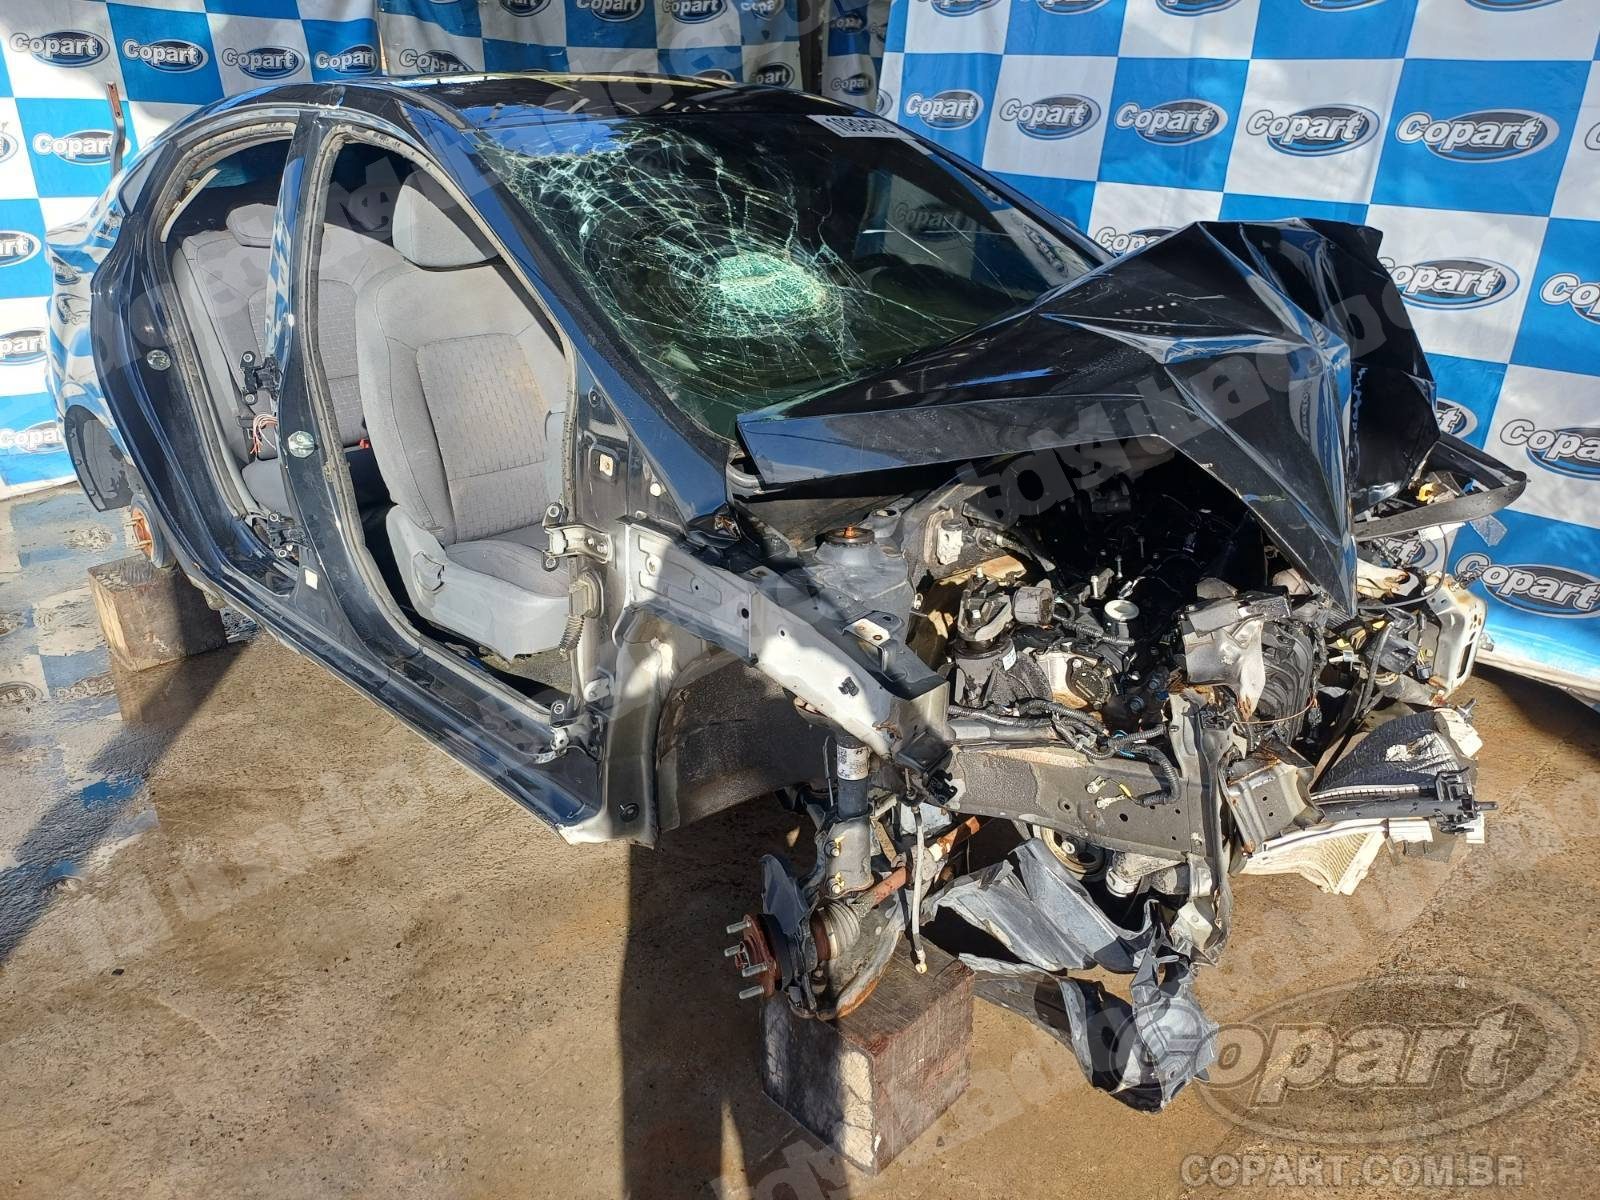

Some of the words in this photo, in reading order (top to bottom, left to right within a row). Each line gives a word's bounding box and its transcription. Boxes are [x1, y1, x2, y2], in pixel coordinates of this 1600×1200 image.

[9, 32, 99, 59] Copart
[122, 39, 199, 68] Copart
[222, 48, 294, 71] Copart
[905, 94, 976, 121] Copart
[1000, 98, 1087, 128] Copart
[1115, 103, 1216, 138] Copart
[1246, 110, 1367, 144] Copart
[1396, 113, 1545, 153] Copart
[33, 132, 113, 159] Copar
[1500, 419, 1600, 461] Copa
[1455, 553, 1600, 612] Copart
